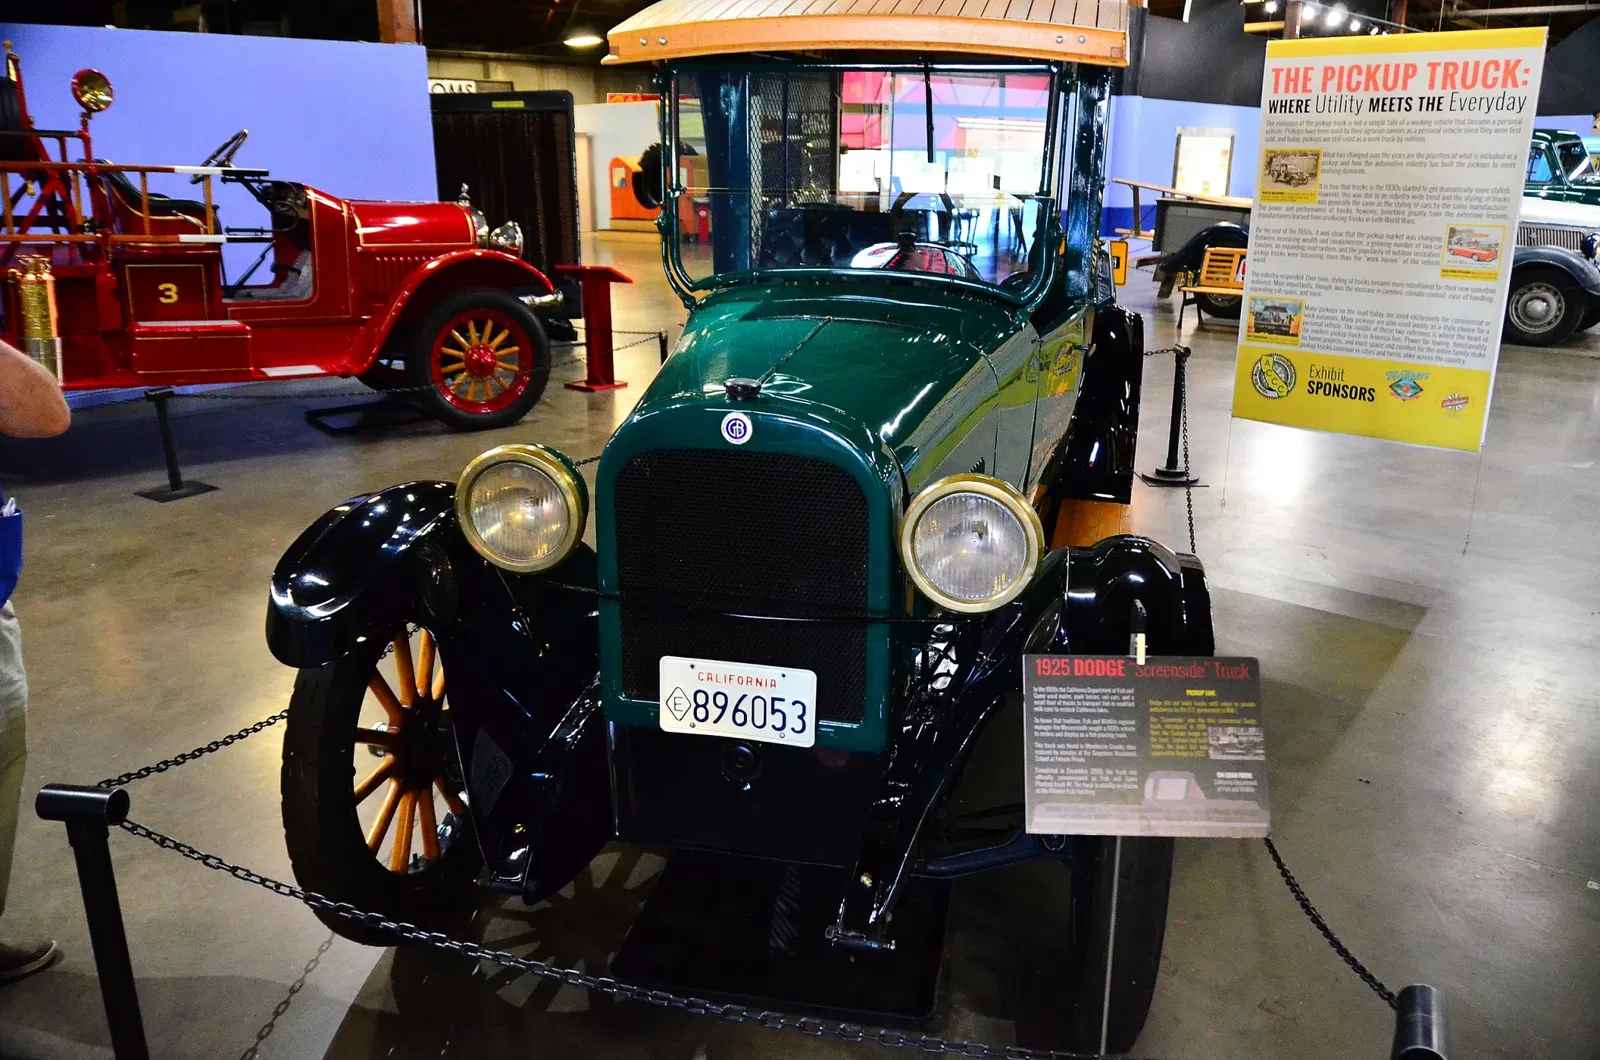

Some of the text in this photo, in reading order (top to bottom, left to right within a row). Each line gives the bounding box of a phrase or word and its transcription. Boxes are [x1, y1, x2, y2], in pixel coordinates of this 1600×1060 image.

[1272, 59, 1530, 94] THE PICKUP TRUCK:
[1268, 92, 1527, 116] WHERE Utility MEETS THE Everyday
[158, 283, 178, 304] 3
[1309, 364, 1344, 382] Exhibit
[1308, 380, 1376, 402] SPONSORS
[698, 671, 778, 688] CALIFORNIA
[1036, 659, 1070, 676] 1925
[1074, 660, 1126, 676] DODGE
[1213, 662, 1249, 680] Truck
[674, 689, 806, 734] E 896053
